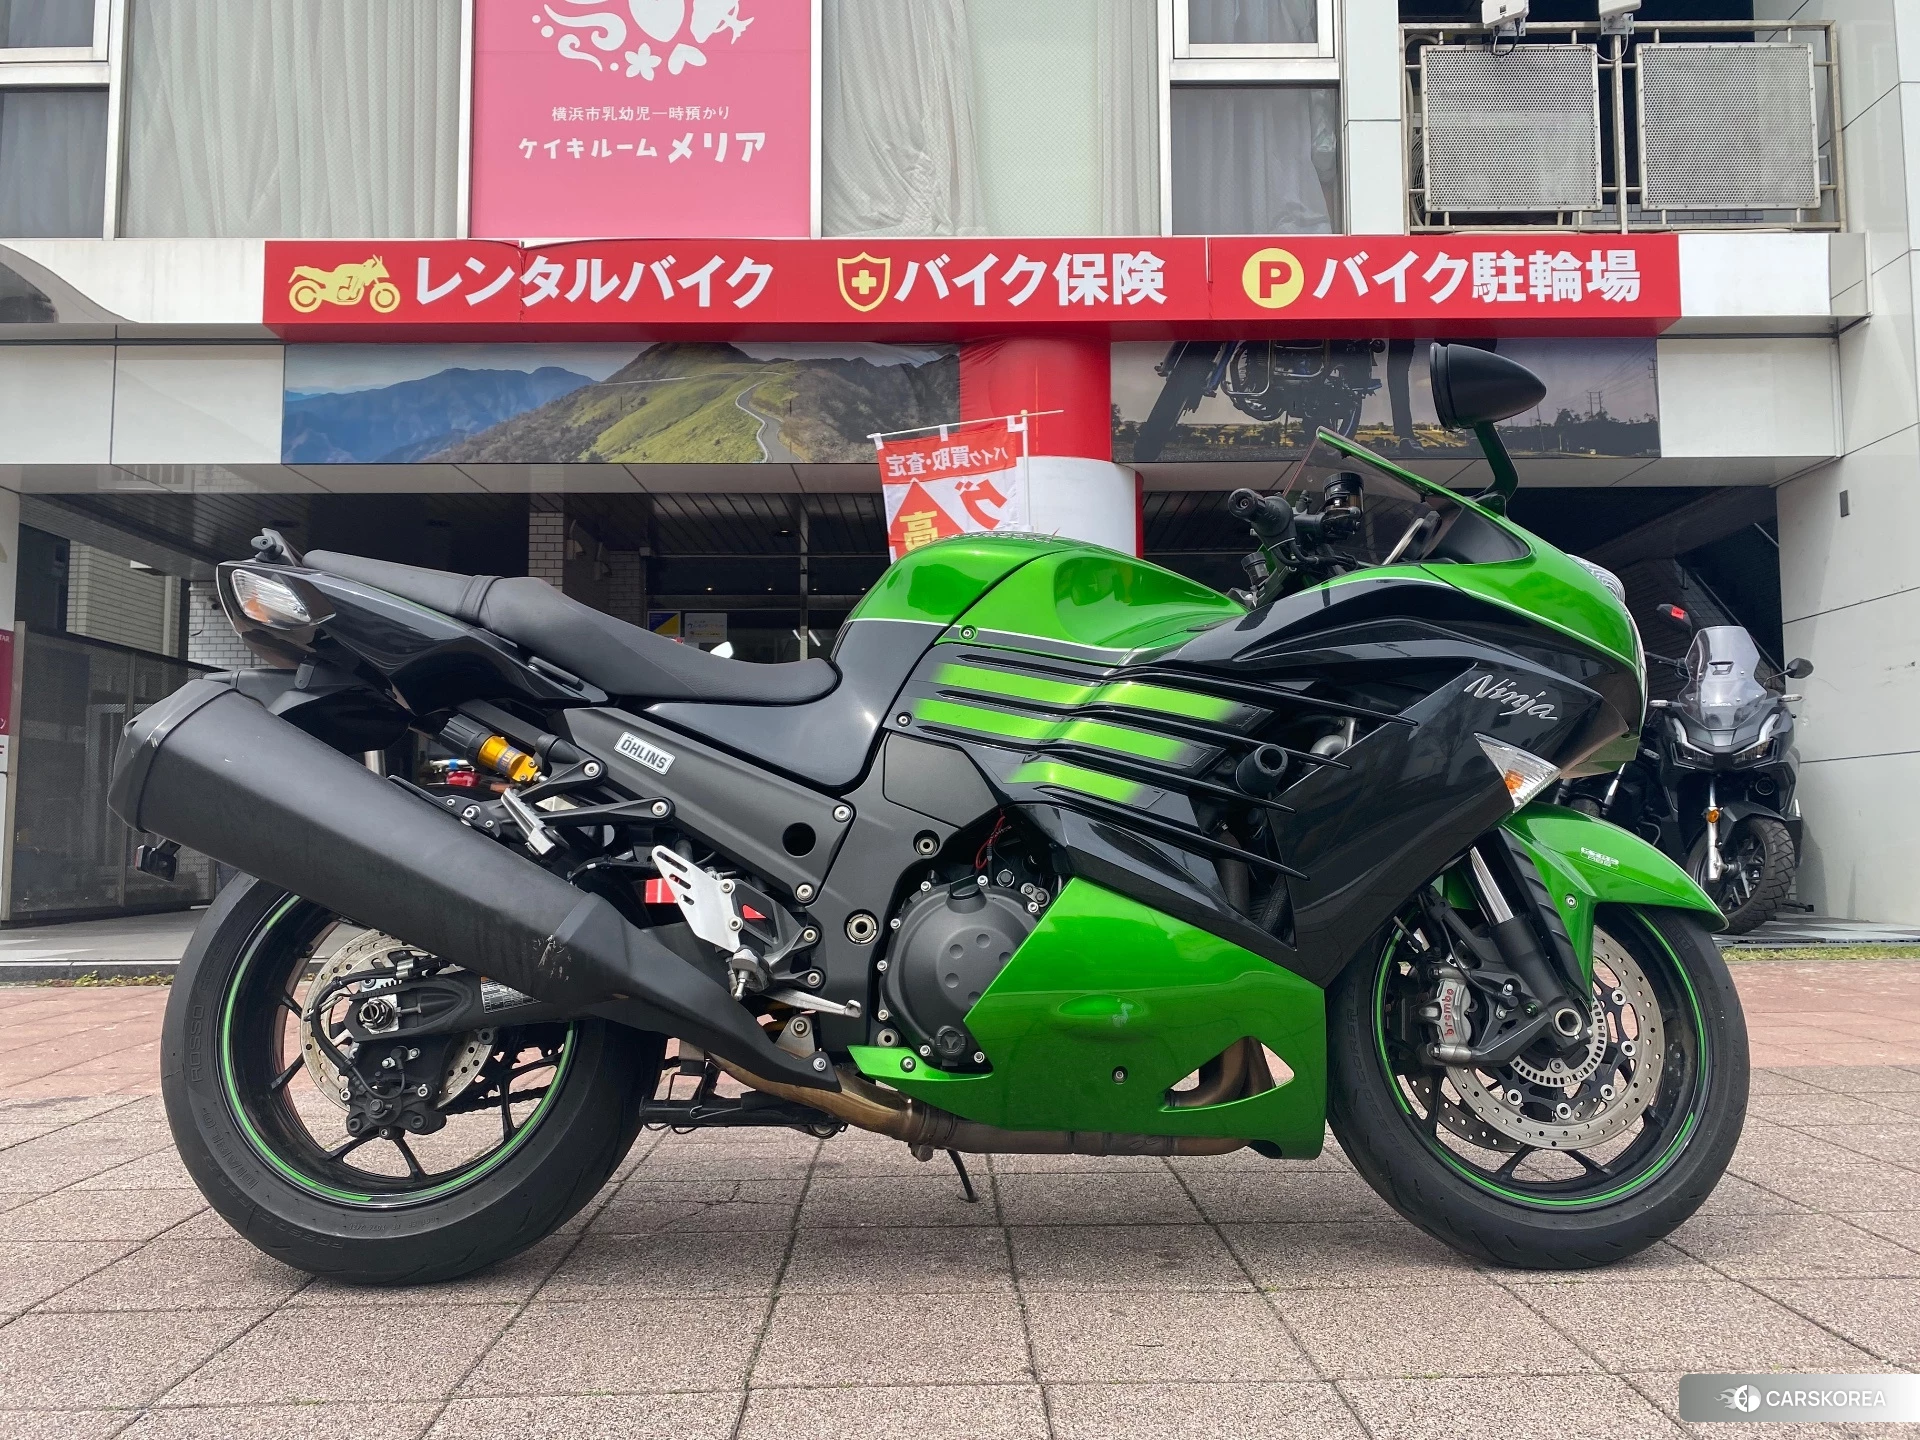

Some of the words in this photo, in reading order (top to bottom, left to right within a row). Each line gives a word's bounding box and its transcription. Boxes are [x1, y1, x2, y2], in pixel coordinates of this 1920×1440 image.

[551, 106, 730, 122] 横浜市乳幼児一時預かり
[518, 137, 658, 160] ケイキルーム
[667, 132, 766, 164] メリア
[416, 255, 774, 309] レンタルバイク
[894, 251, 1168, 306] バイク保険
[1312, 249, 1641, 304] バイク駐輪場
[1463, 674, 1559, 721] Ninja
[620, 736, 668, 769] ÖHLINS
[1441, 988, 1455, 1036] brembo
